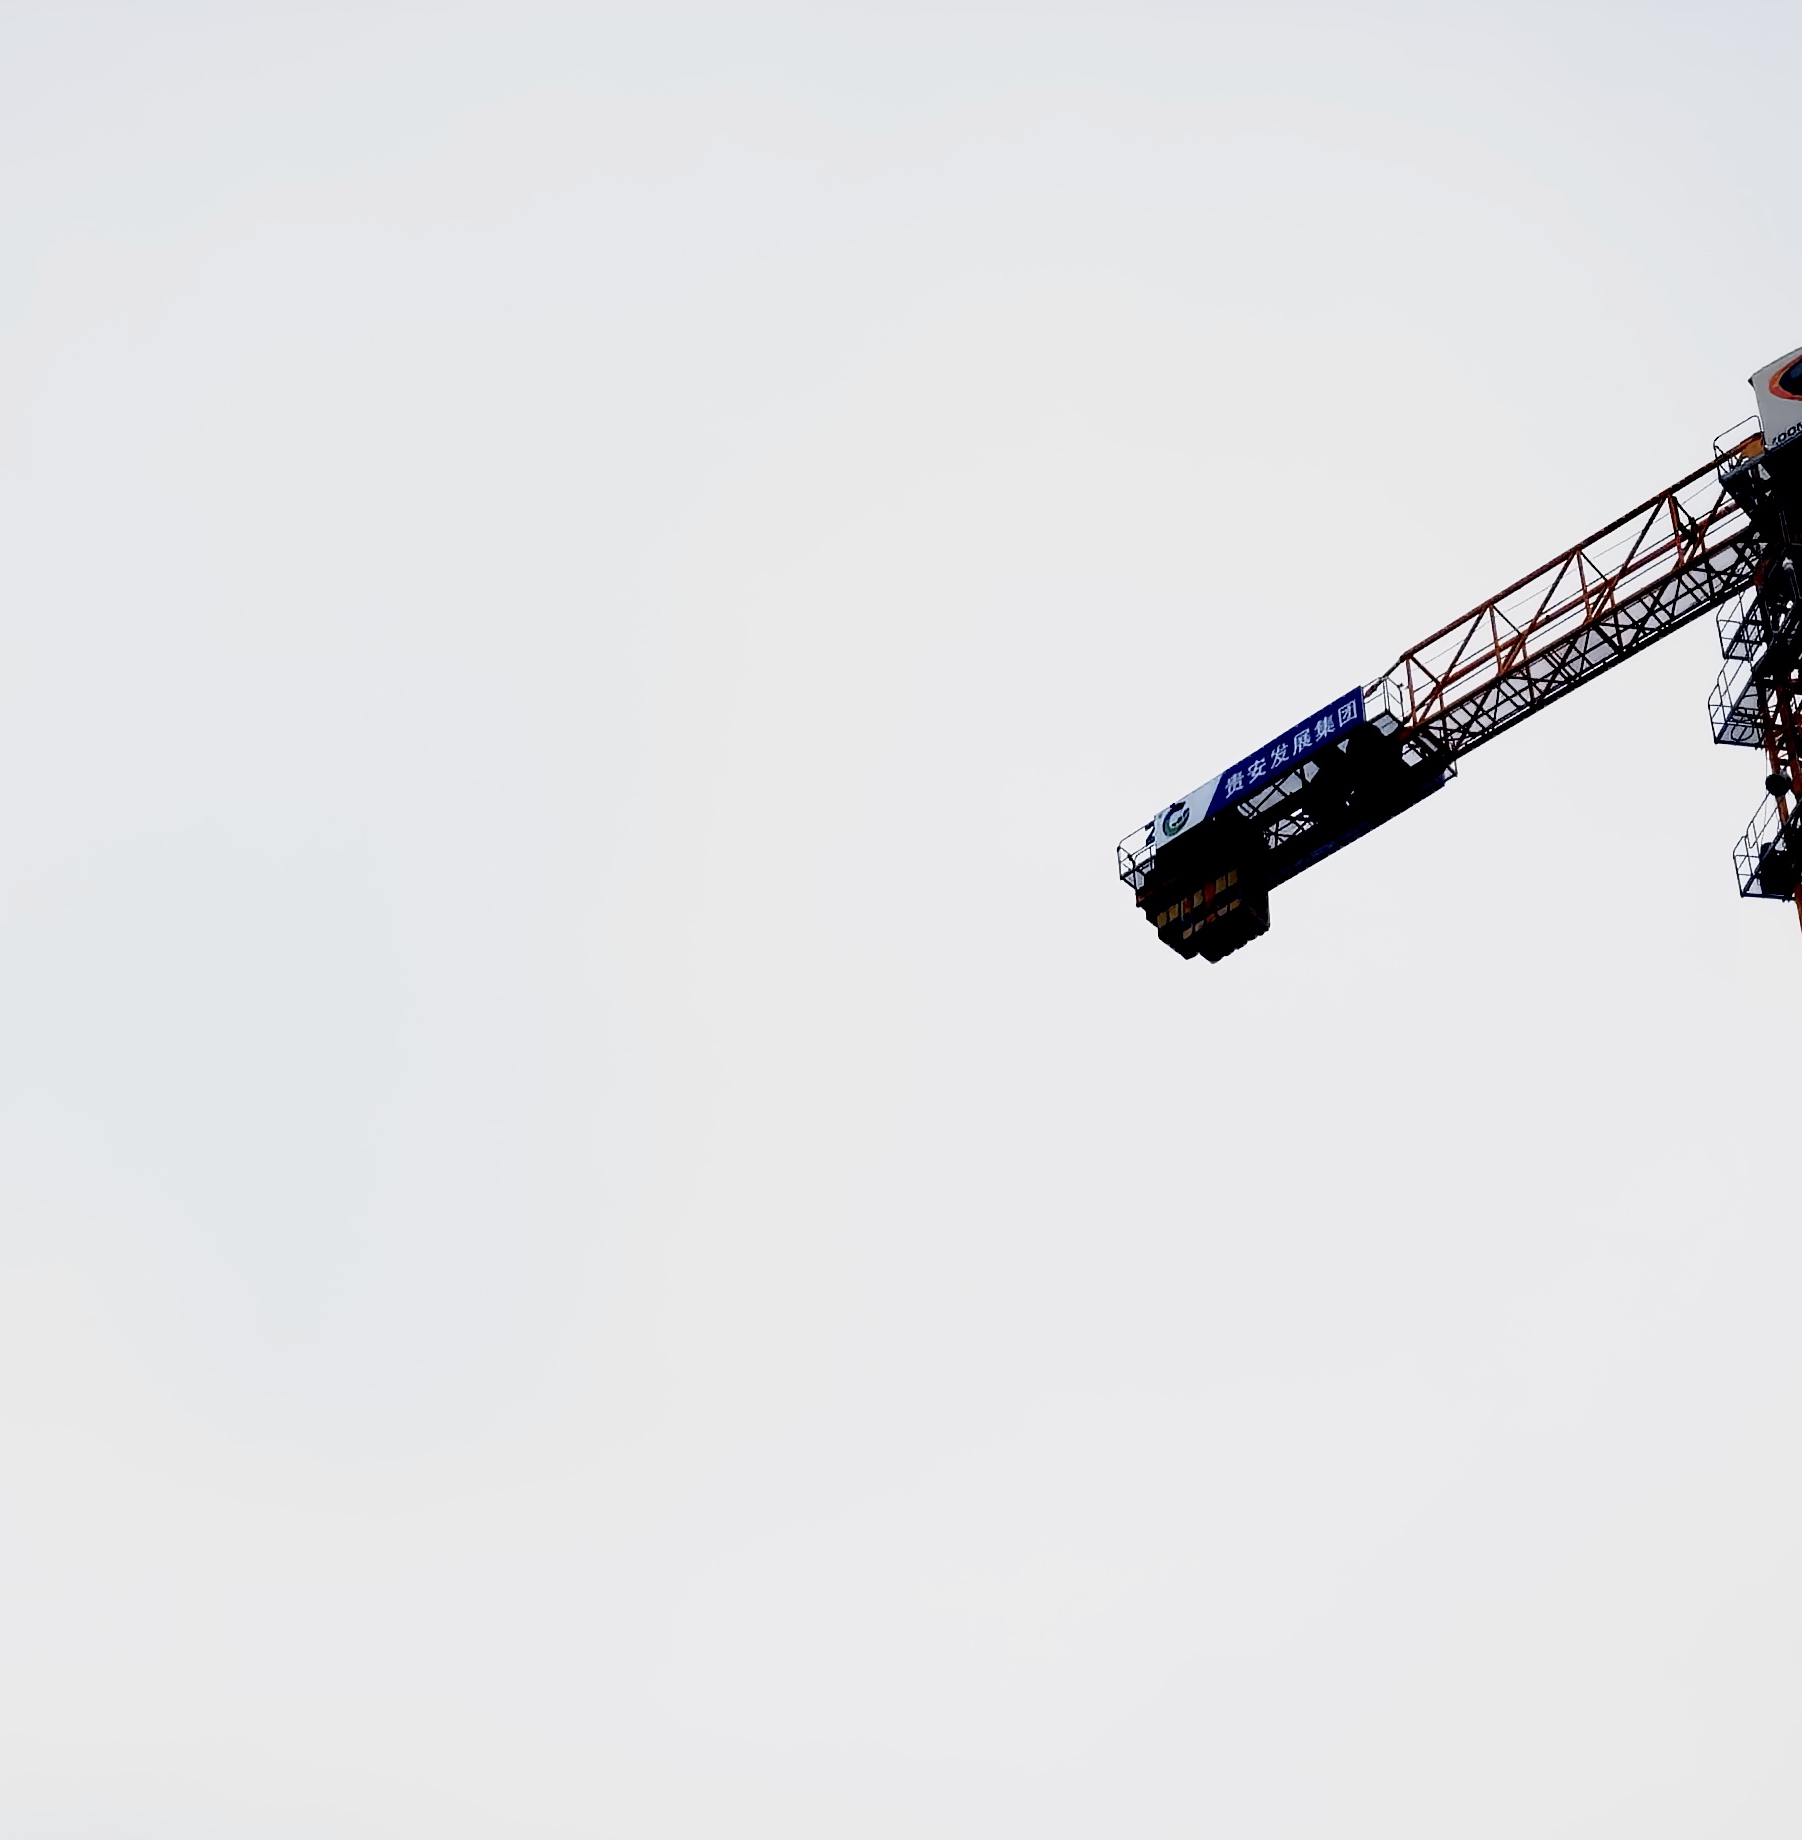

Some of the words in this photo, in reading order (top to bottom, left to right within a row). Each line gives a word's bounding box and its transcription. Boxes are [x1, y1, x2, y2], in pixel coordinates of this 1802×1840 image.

[1225, 700, 1357, 798] 贵安发展集团
